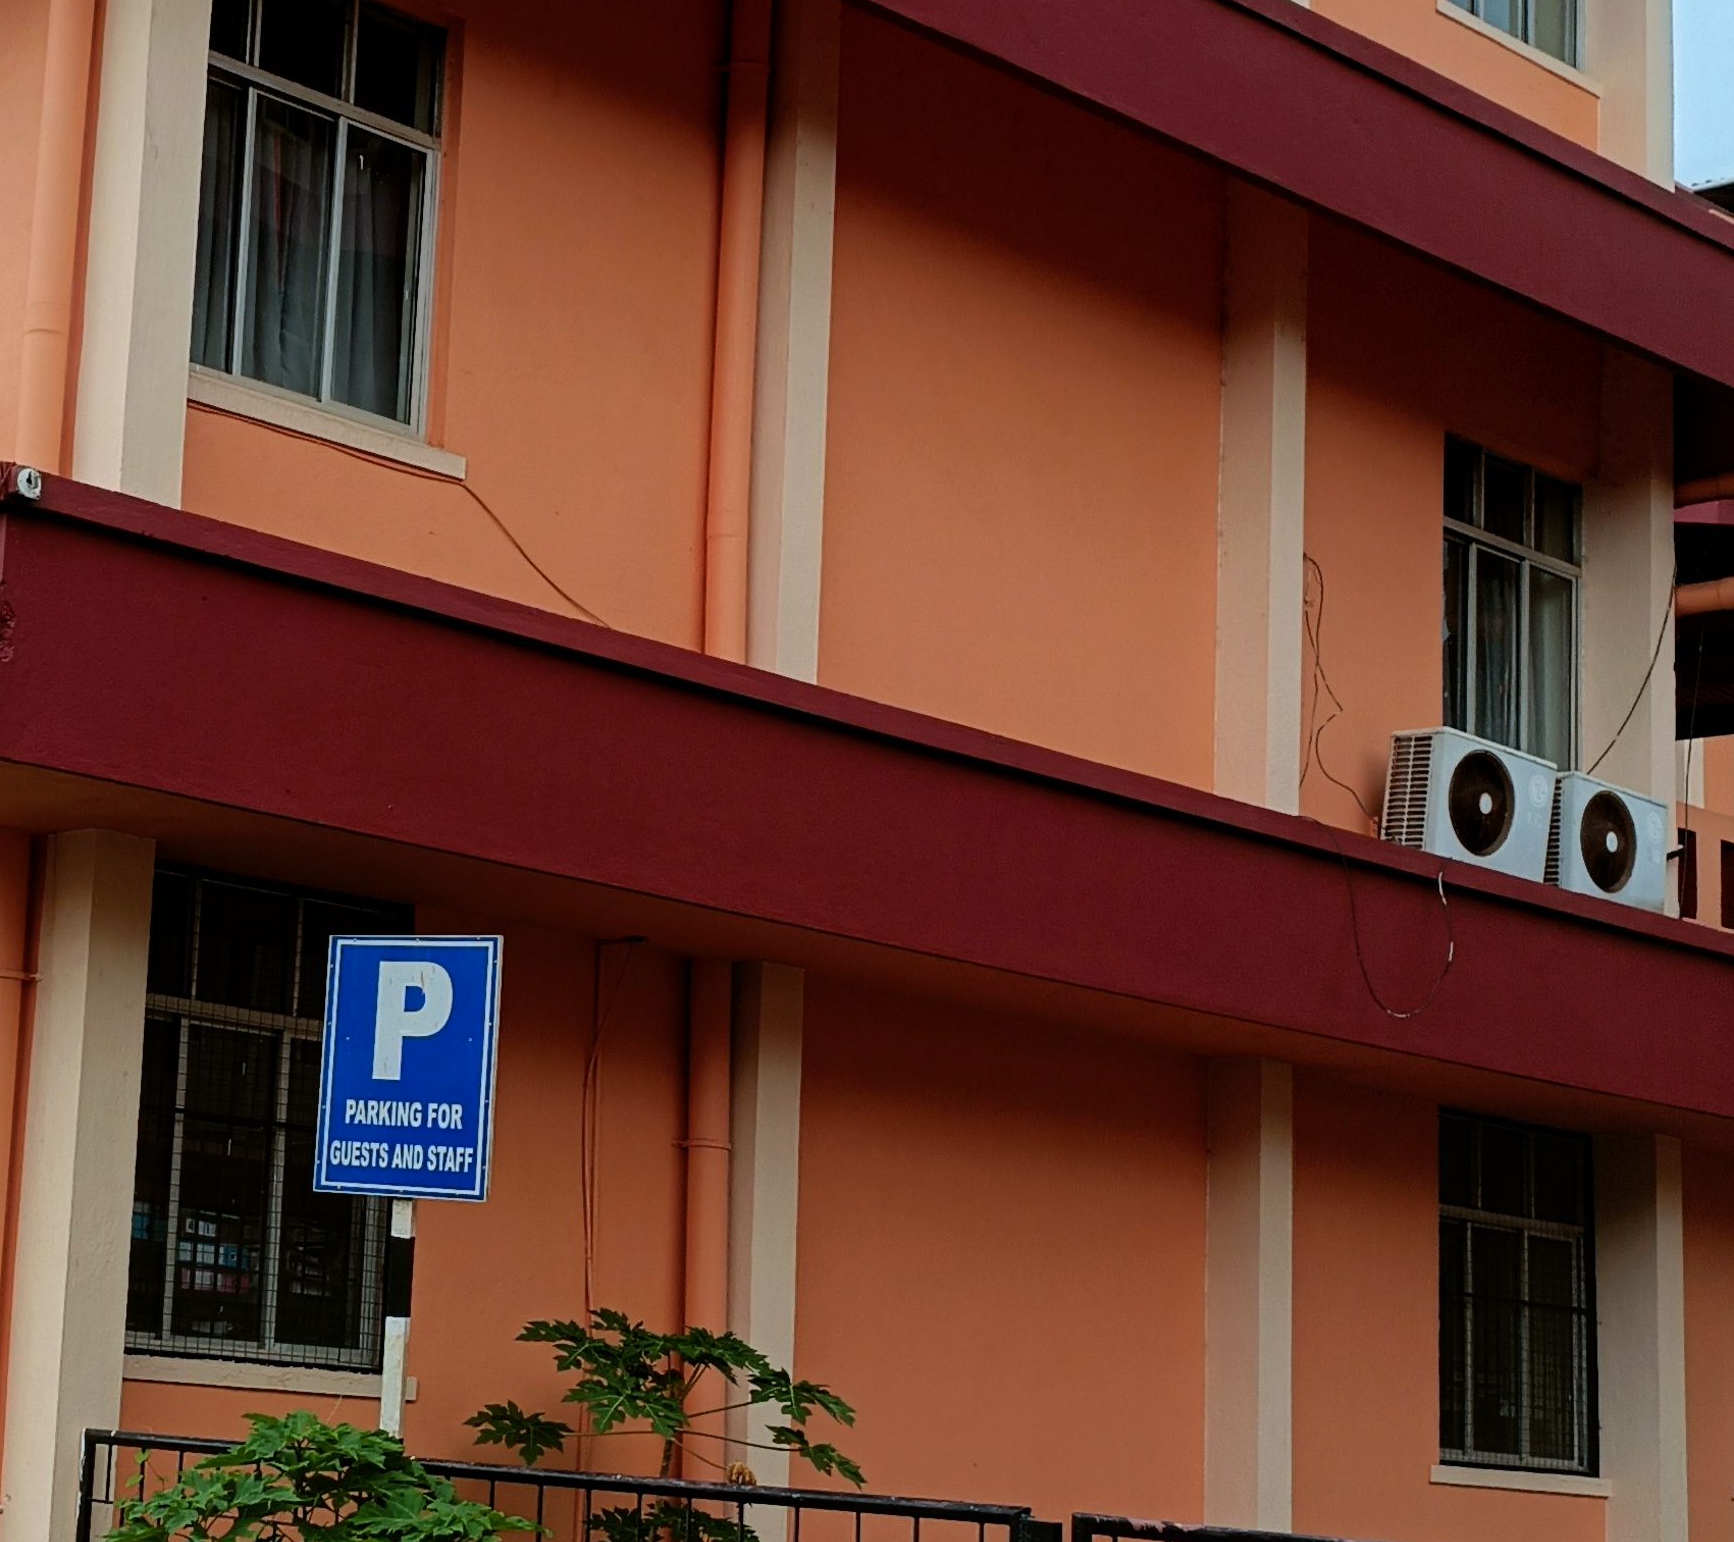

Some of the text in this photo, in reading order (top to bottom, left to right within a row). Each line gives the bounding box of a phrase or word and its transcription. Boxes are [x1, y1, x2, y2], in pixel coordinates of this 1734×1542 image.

[372, 961, 453, 1080] P
[345, 1099, 463, 1130] PARKING FOR
[330, 1140, 474, 1173] GUESTS AND STAFF
